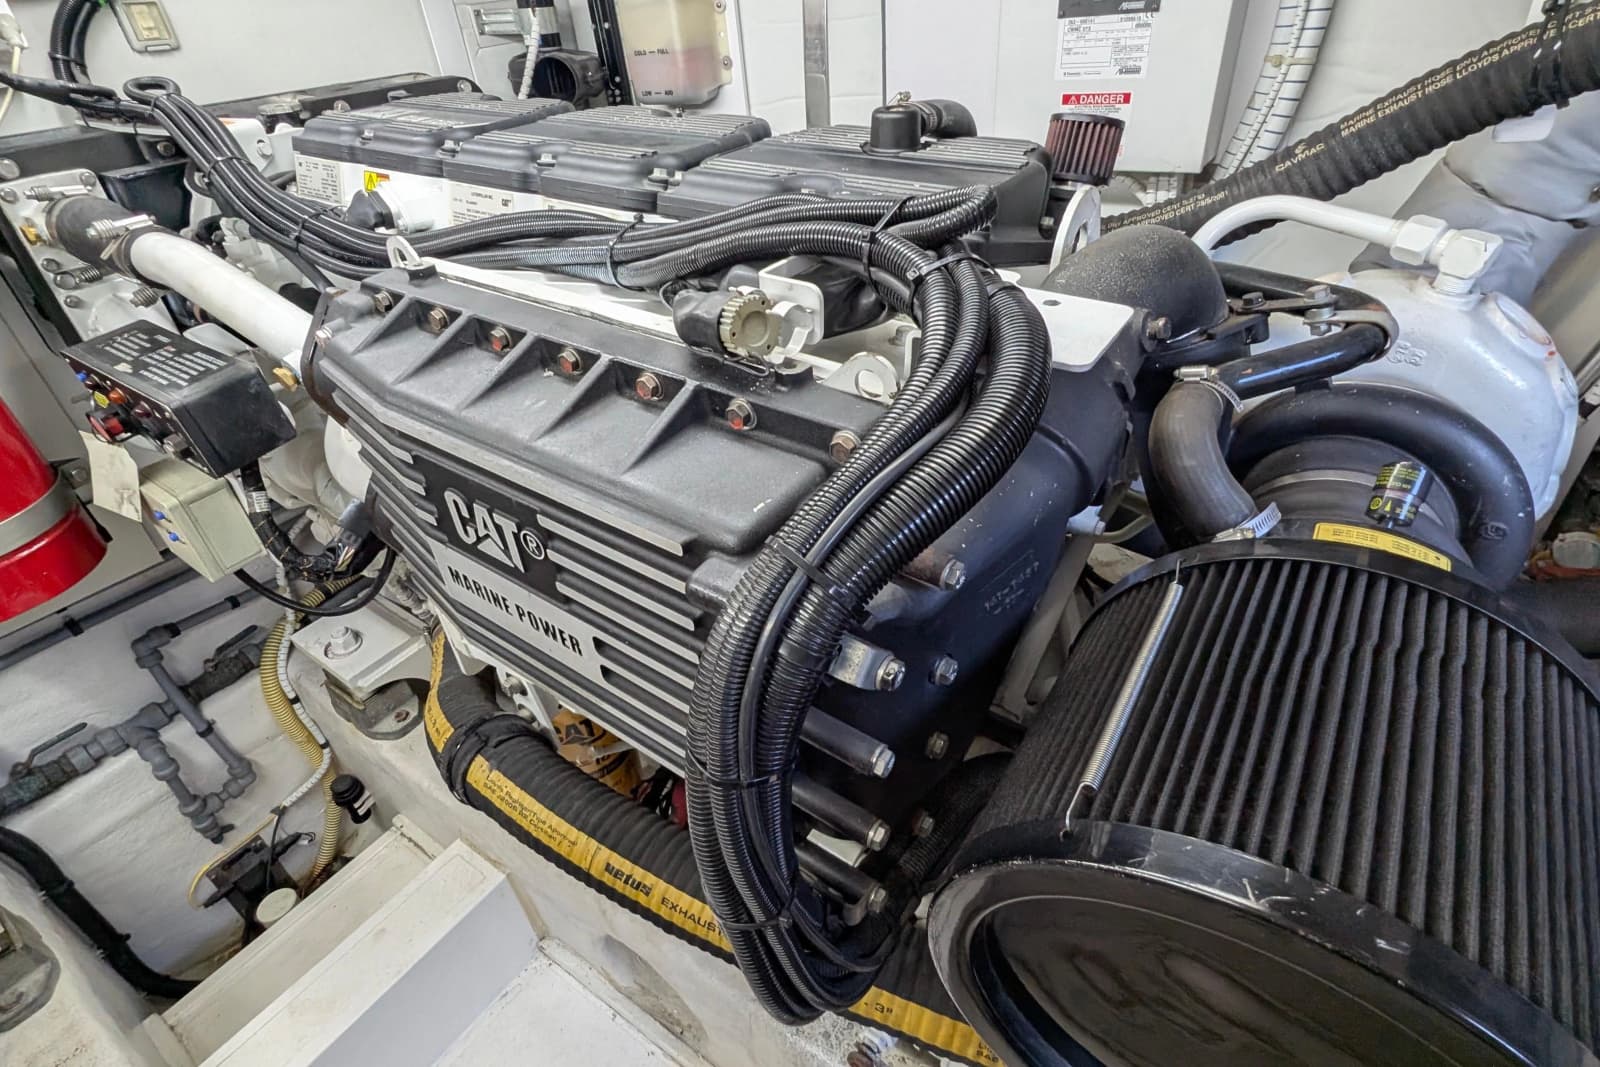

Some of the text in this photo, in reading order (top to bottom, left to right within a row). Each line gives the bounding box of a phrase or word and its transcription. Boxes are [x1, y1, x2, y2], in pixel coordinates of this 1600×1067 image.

[1079, 94, 1125, 105] DANGER
[1340, 107, 1375, 129] MARINE
[1376, 83, 1422, 110] EXHAUST
[1424, 67, 1453, 86] HOSE
[1456, 56, 1479, 71] DNV
[1341, 115, 1377, 138] MARINE
[1378, 90, 1424, 118] EXHAUST
[1425, 74, 1454, 95] HOSE
[1456, 55, 1500, 80] LLOYDS
[1274, 142, 1327, 173] CAVMAC
[1123, 209, 1161, 225] APPROVED
[1162, 202, 1181, 214] CERT
[1176, 203, 1196, 216] CERT
[448, 566, 583, 656] MARINE POWER
[661, 896, 725, 936] EXHAUST
